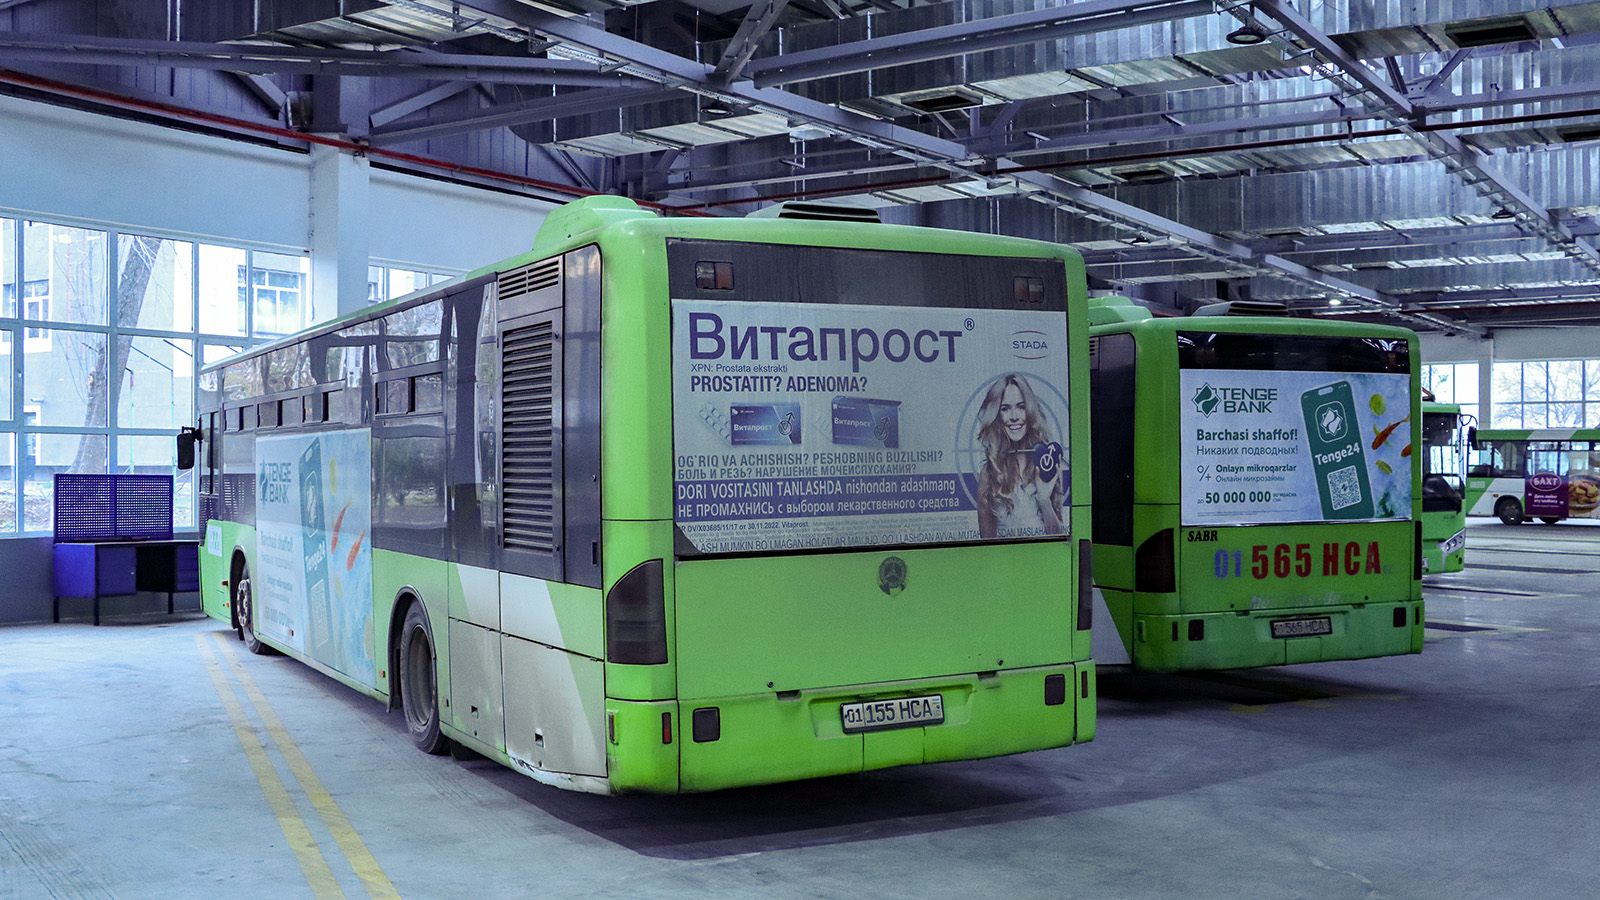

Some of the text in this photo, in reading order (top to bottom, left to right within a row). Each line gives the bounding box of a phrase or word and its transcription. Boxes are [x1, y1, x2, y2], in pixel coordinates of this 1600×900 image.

[1012, 340, 1048, 350] STADA
[690, 363, 788, 373] XPN: Prostata ekstrakti
[691, 375, 868, 392] PROSTATIT? ADENOMA?
[1219, 388, 1278, 401] TENGE
[1223, 401, 1273, 414] BANK
[1196, 428, 1298, 441] Barchasi shaffof!
[1196, 445, 1298, 456] Никаких подводных!
[1314, 442, 1360, 467] Tenge24
[722, 455, 736, 467] VA
[740, 453, 809, 467] ACHISHISH?
[812, 451, 883, 465] PESHOBNING
[886, 450, 944, 463] BUZILISHI?
[267, 462, 292, 483] TENGE
[678, 464, 917, 480] БОЛЬ И РЕЗЬ? НАРУШЕНИЕ МОЧЕИСПУСКАНИЯ?
[1216, 464, 1297, 474] Onlayn mikroqarzlar
[1533, 477, 1558, 486] БАХТ
[268, 483, 291, 505] BANK
[678, 478, 955, 500] DORI VOSITASINI TANLASHDA nishondan adashmang
[1205, 492, 1220, 504] 50
[1223, 491, 1246, 503] 000
[1249, 491, 1271, 503] 000
[678, 504, 692, 517] НЕ
[696, 502, 774, 517] ПРОМАХНИСЬ
[786, 499, 834, 515] выбором
[837, 498, 915, 514] лекарственного
[918, 497, 960, 511] средства
[1187, 530, 1218, 542] SABR
[720, 541, 753, 552] MUMKIN
[1214, 541, 1381, 579] 01 565 HCA
[1285, 621, 1304, 634] 565
[1304, 620, 1325, 632] HCA
[847, 699, 933, 724] 01 155 HCA
